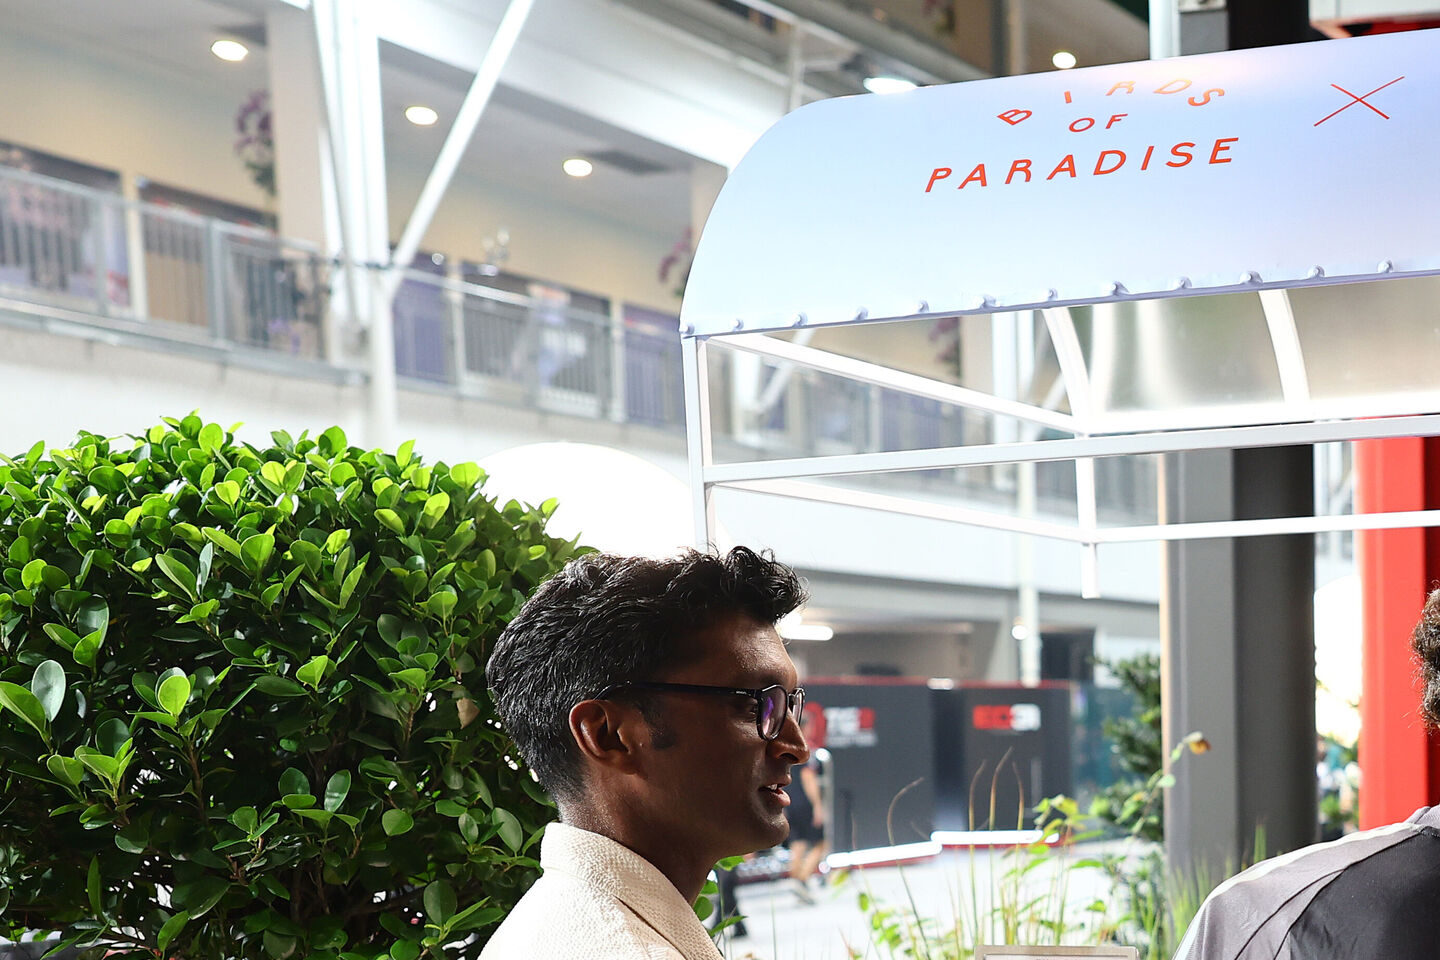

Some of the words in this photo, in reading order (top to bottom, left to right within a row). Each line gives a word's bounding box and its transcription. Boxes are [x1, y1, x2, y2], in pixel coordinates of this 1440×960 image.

[997, 79, 1225, 126] BIRDS
[1069, 113, 1128, 133] OF
[924, 137, 1239, 194] PARADISE
